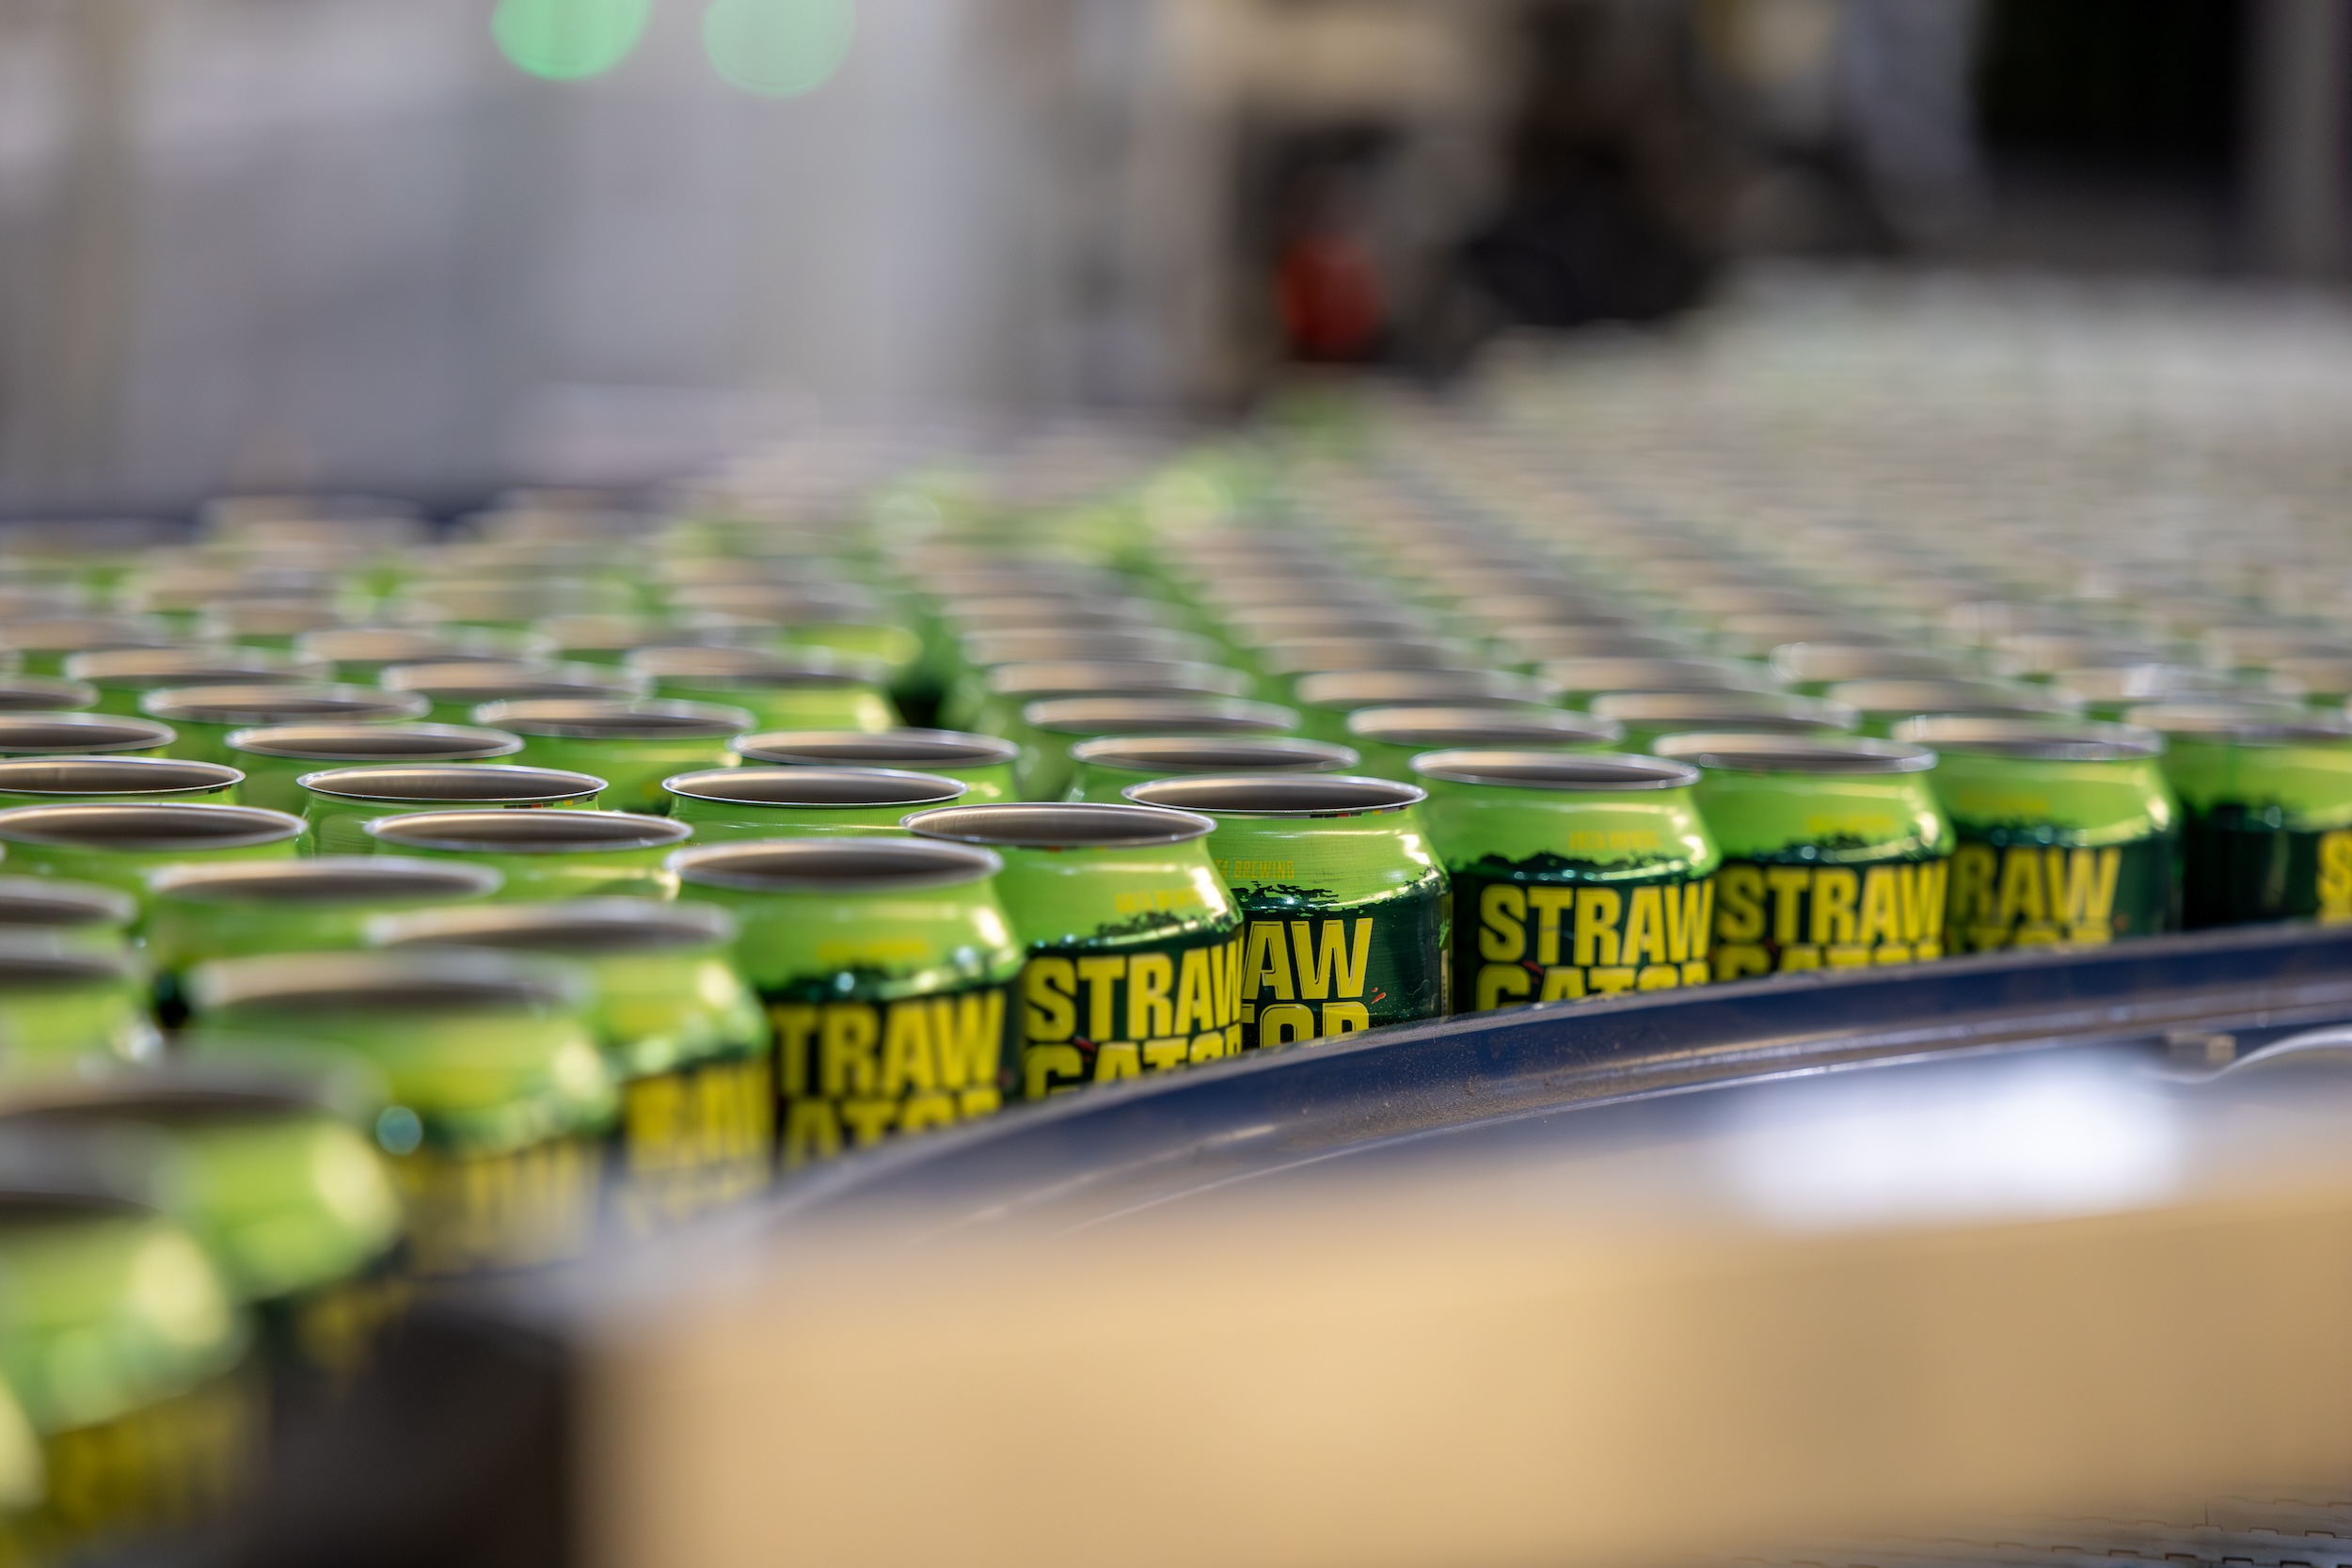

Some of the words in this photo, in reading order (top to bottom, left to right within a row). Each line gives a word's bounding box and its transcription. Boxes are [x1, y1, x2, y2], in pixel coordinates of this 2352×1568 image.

[1233, 860, 1295, 879] BREWING
[1718, 860, 1948, 946] STRAW
[1479, 878, 1715, 966] STRAW
[1026, 941, 1244, 1043] STRAW
[771, 990, 1006, 1099] TRAW
